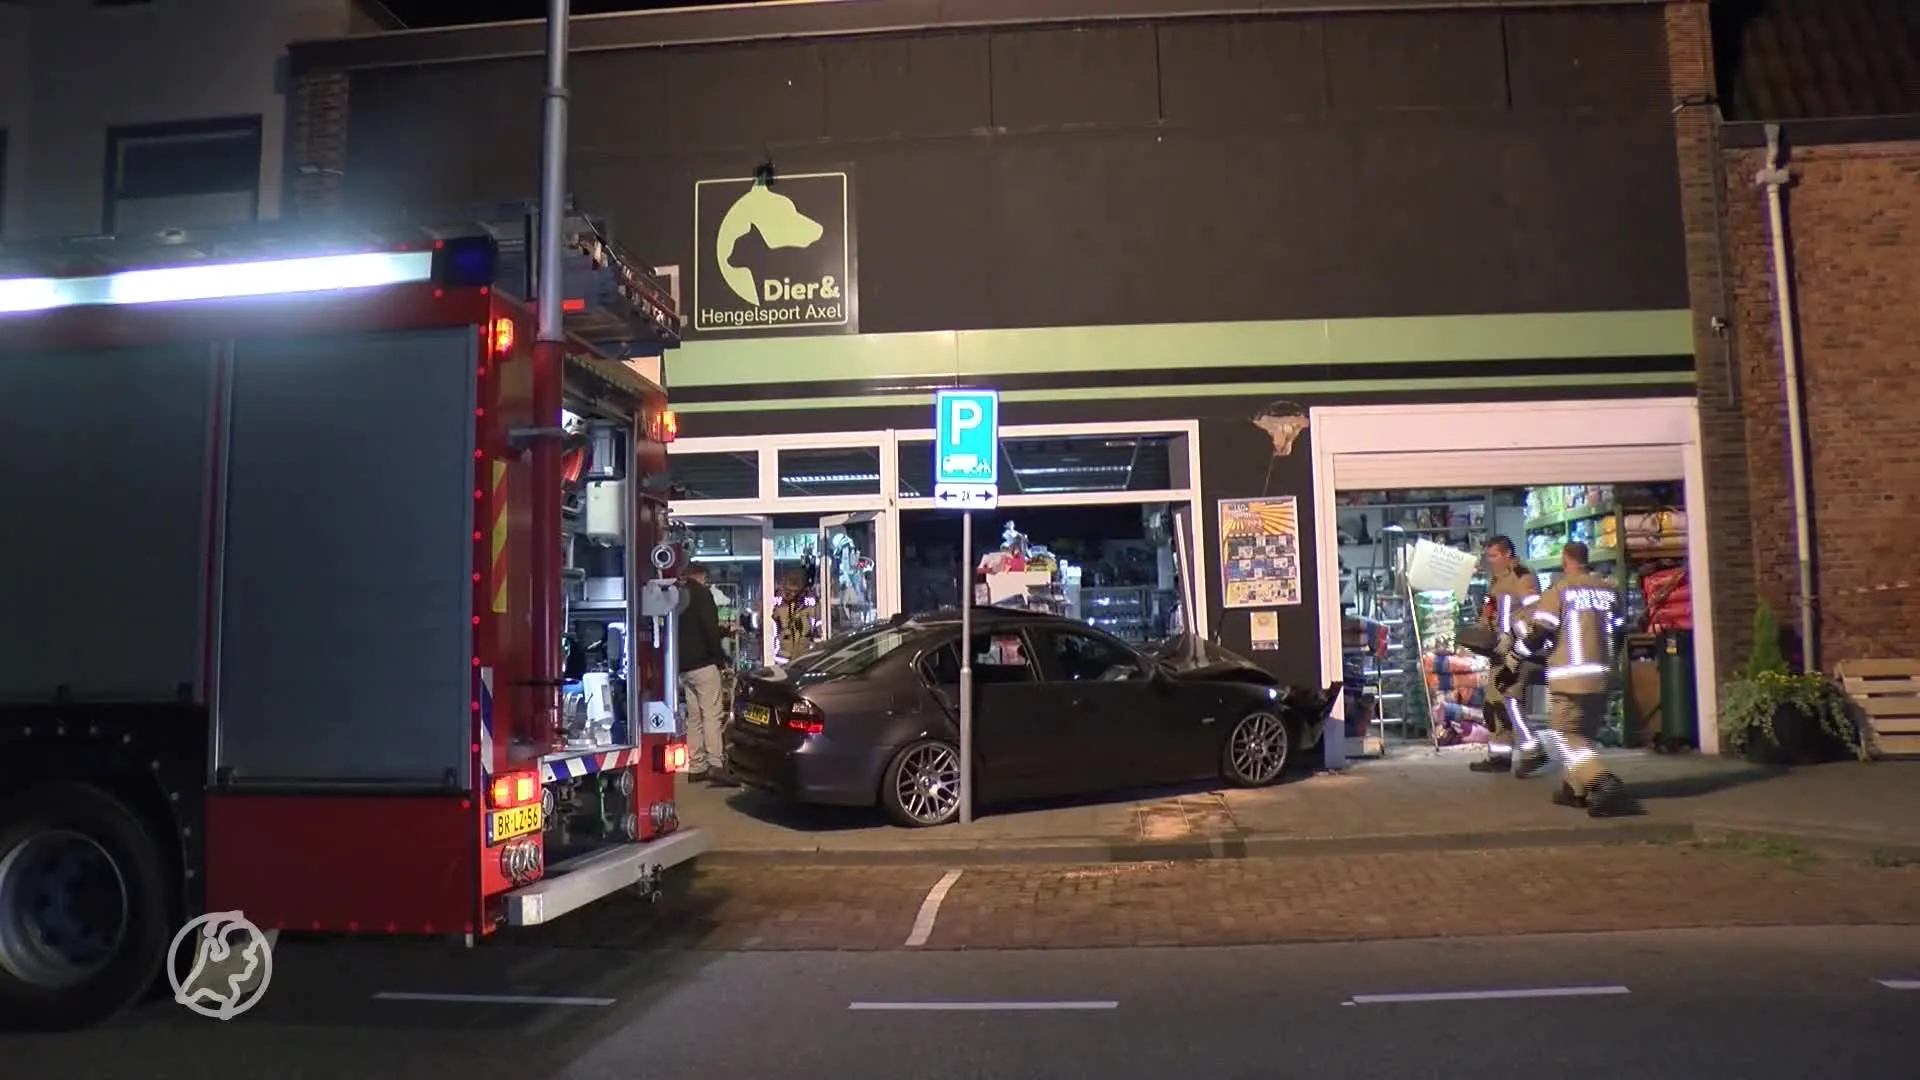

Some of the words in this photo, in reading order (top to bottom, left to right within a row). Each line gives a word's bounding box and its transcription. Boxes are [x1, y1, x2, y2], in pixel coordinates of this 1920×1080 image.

[763, 275, 841, 301] Dier&
[701, 305, 800, 325] Hengelsport
[805, 304, 842, 319] Axel
[951, 399, 984, 446] P
